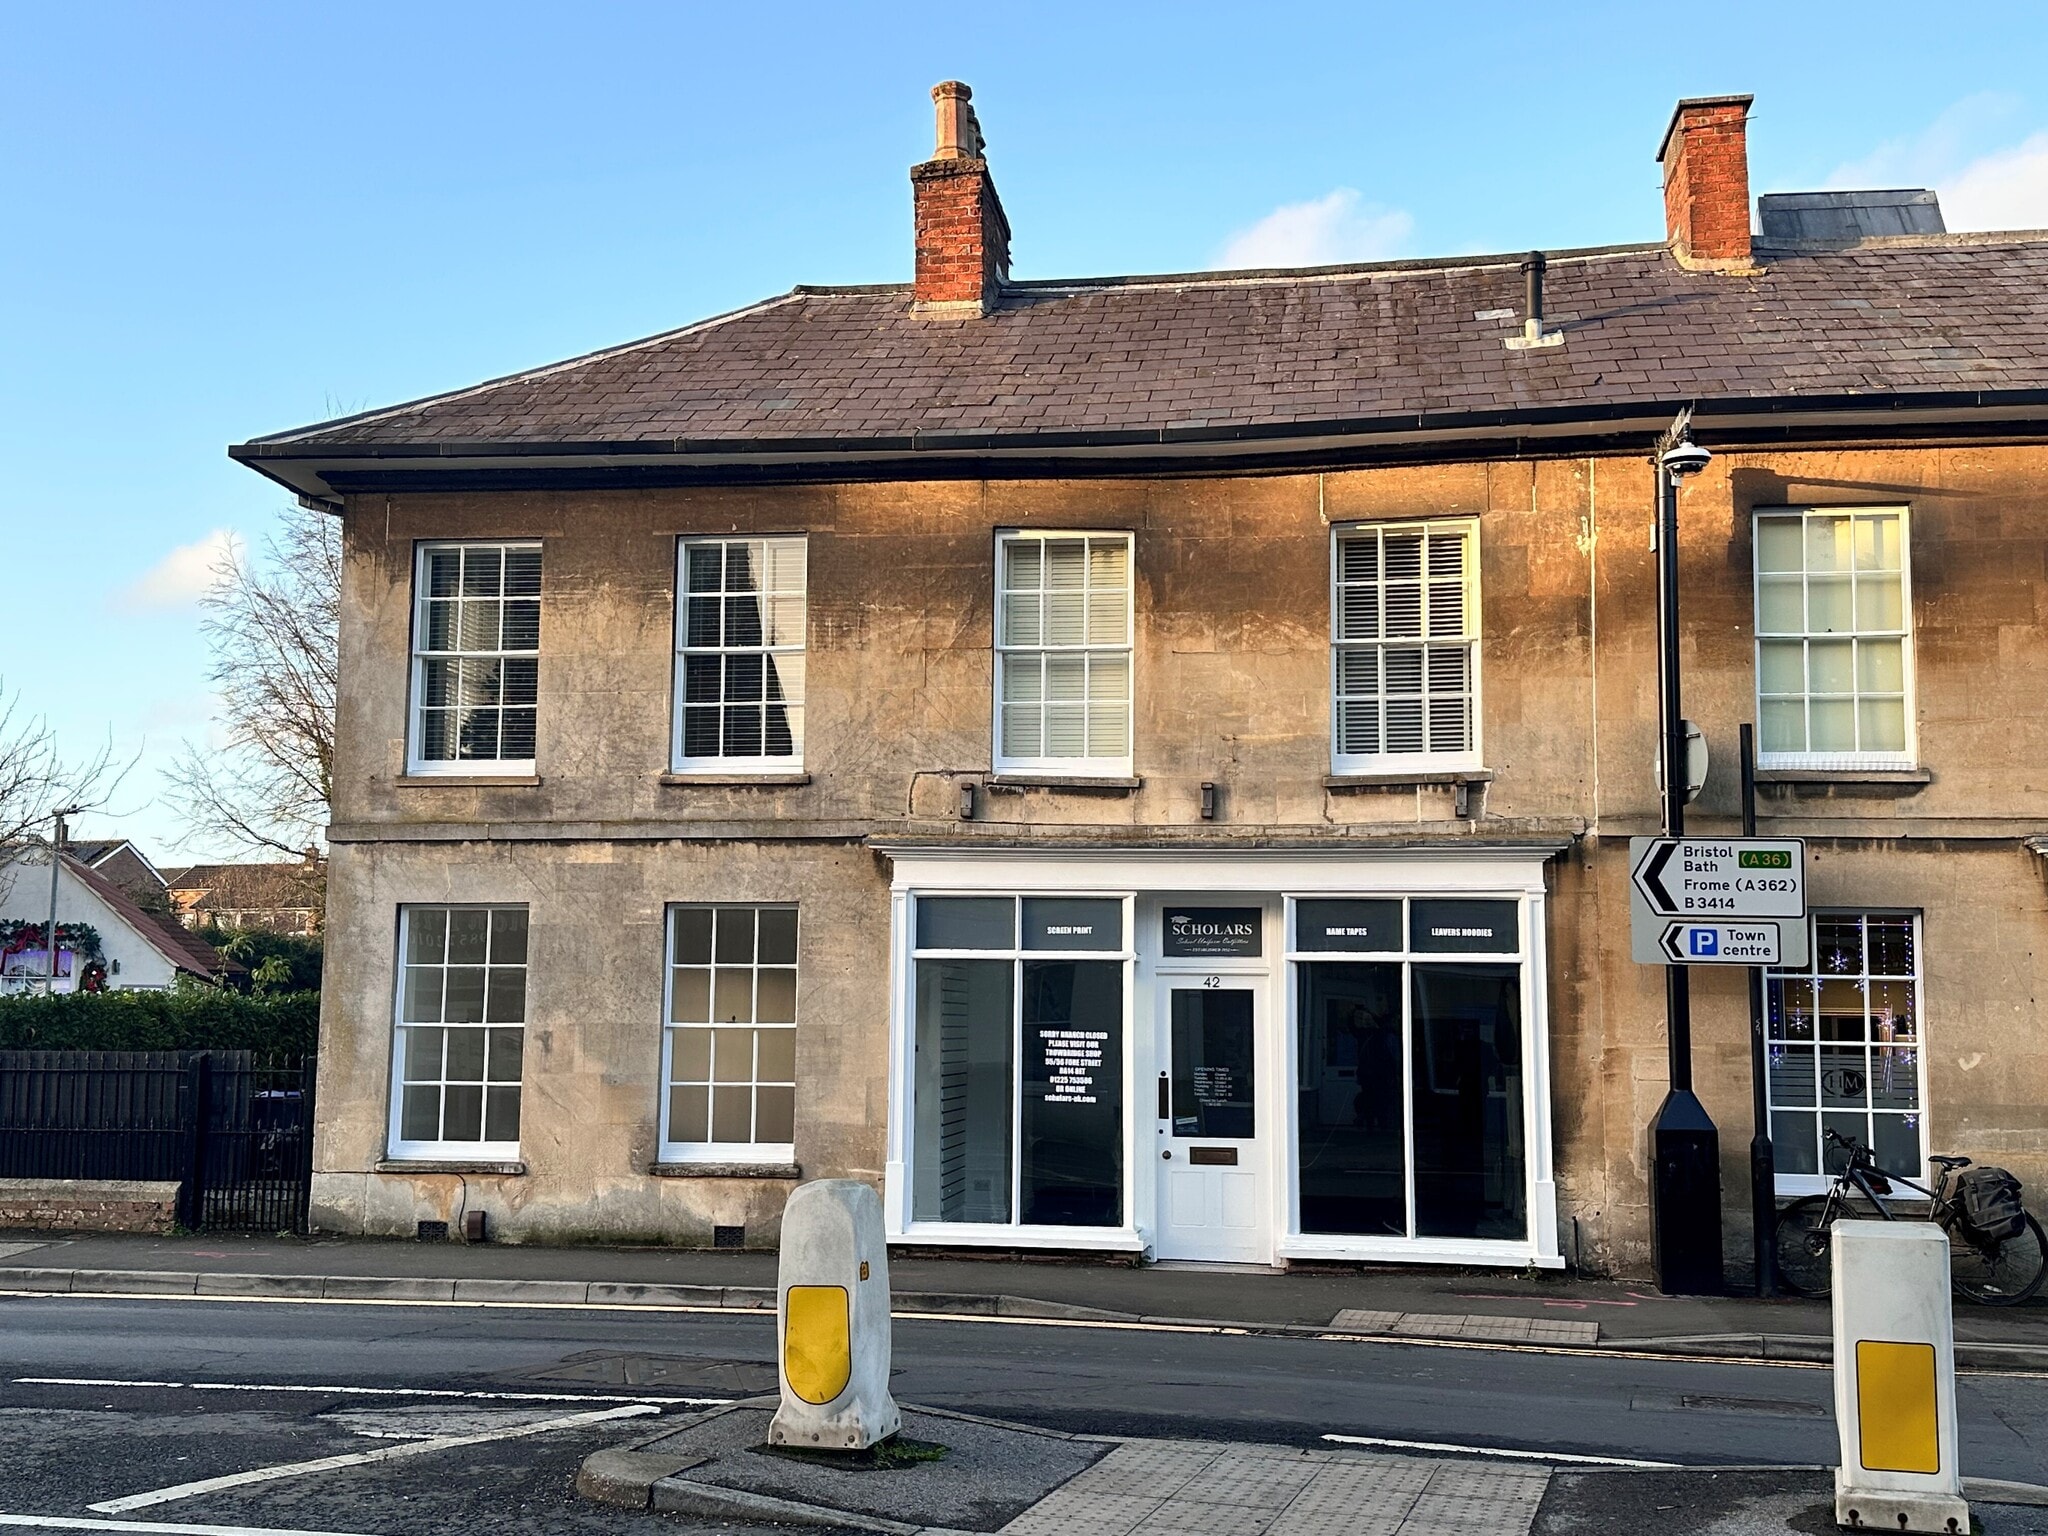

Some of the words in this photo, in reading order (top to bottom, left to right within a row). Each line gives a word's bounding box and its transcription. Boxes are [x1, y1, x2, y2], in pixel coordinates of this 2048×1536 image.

[1684, 846, 1733, 858] Bristol
[1684, 860, 1718, 872] Bath
[1684, 879, 1730, 891] Frome
[1047, 926, 1072, 934] SCREEN
[1073, 926, 1092, 934] PRINT
[1172, 924, 1253, 935] SCHOLARS
[1326, 928, 1345, 936] NAME
[1346, 928, 1367, 936] TAPES
[1432, 928, 1461, 936] LEAVERS
[1462, 928, 1493, 937] HOODIES
[1727, 929, 1766, 941] Town
[1696, 932, 1714, 953] P
[1723, 945, 1771, 956] centre
[1203, 977, 1220, 988] 42
[1040, 1030, 1059, 1038] SORRY
[1070, 1040, 1085, 1048] VISIT
[1080, 1059, 1102, 1067] STREET
[1056, 1085, 1064, 1093] OR
